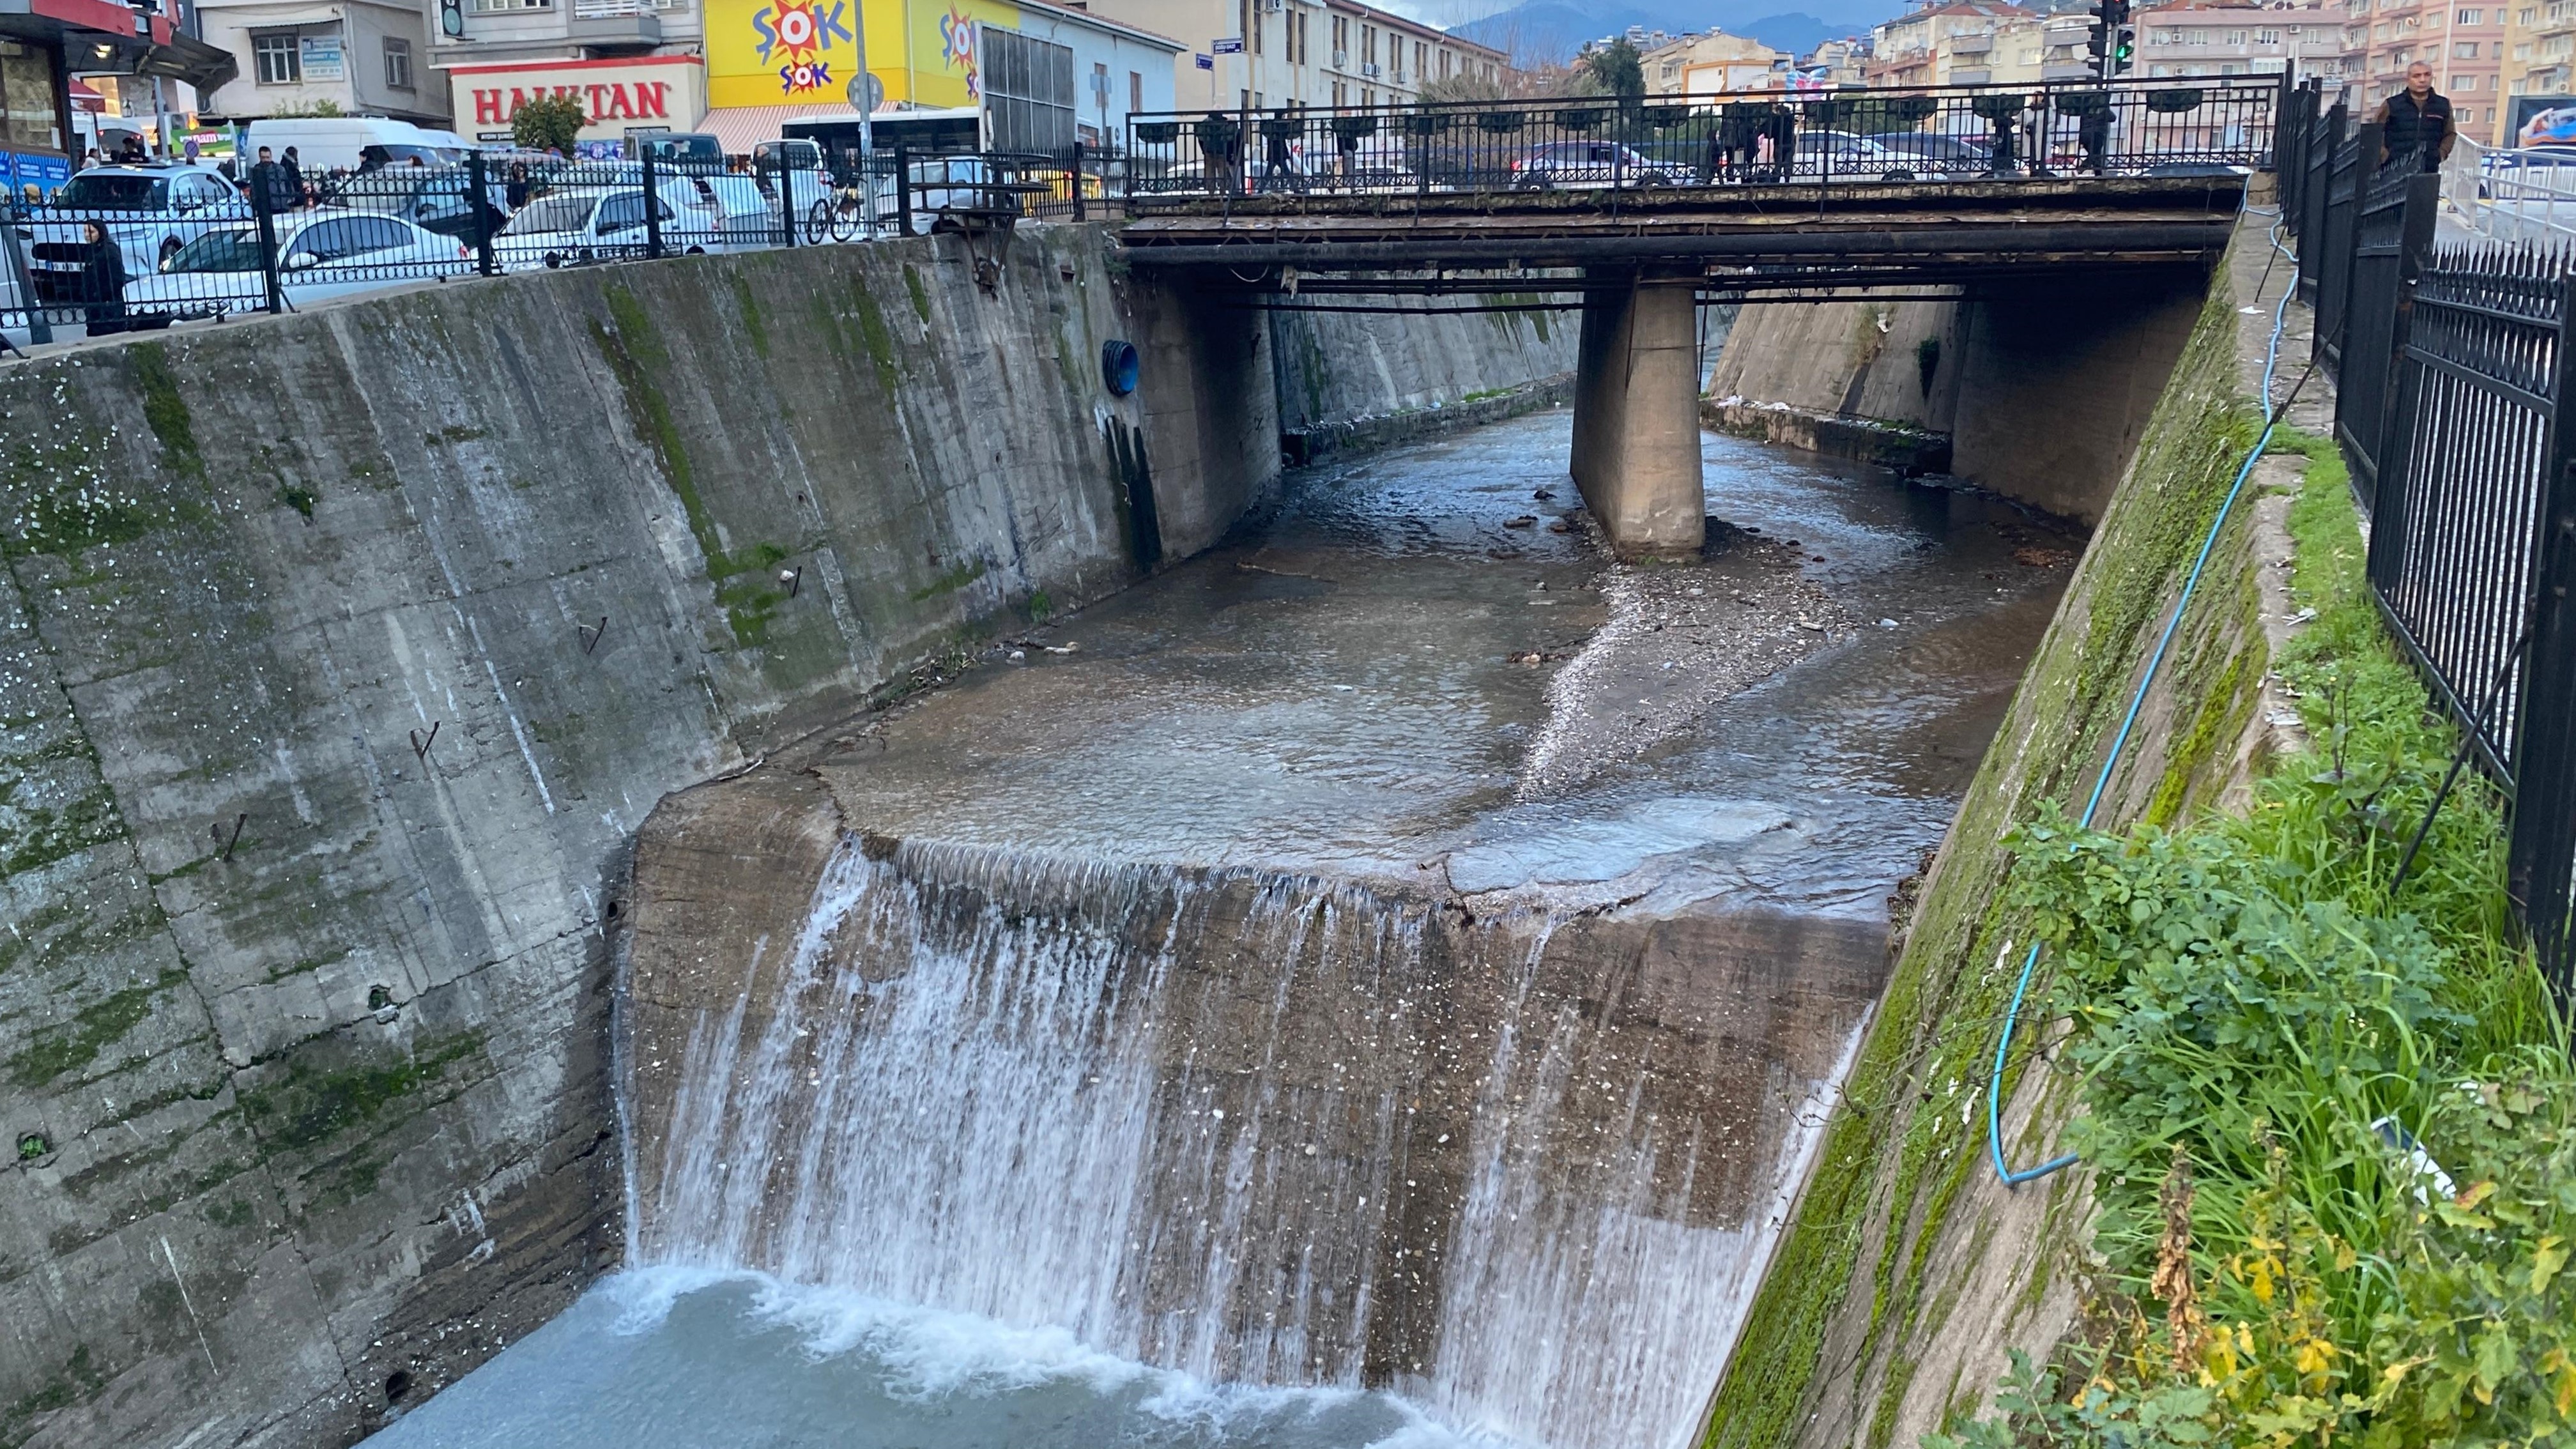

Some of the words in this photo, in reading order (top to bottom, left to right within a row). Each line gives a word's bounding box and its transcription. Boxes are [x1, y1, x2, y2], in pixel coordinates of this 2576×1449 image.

[753, 1, 854, 66] ŞOK
[940, 14, 977, 71] ŞO
[780, 61, 832, 96] ŞOK
